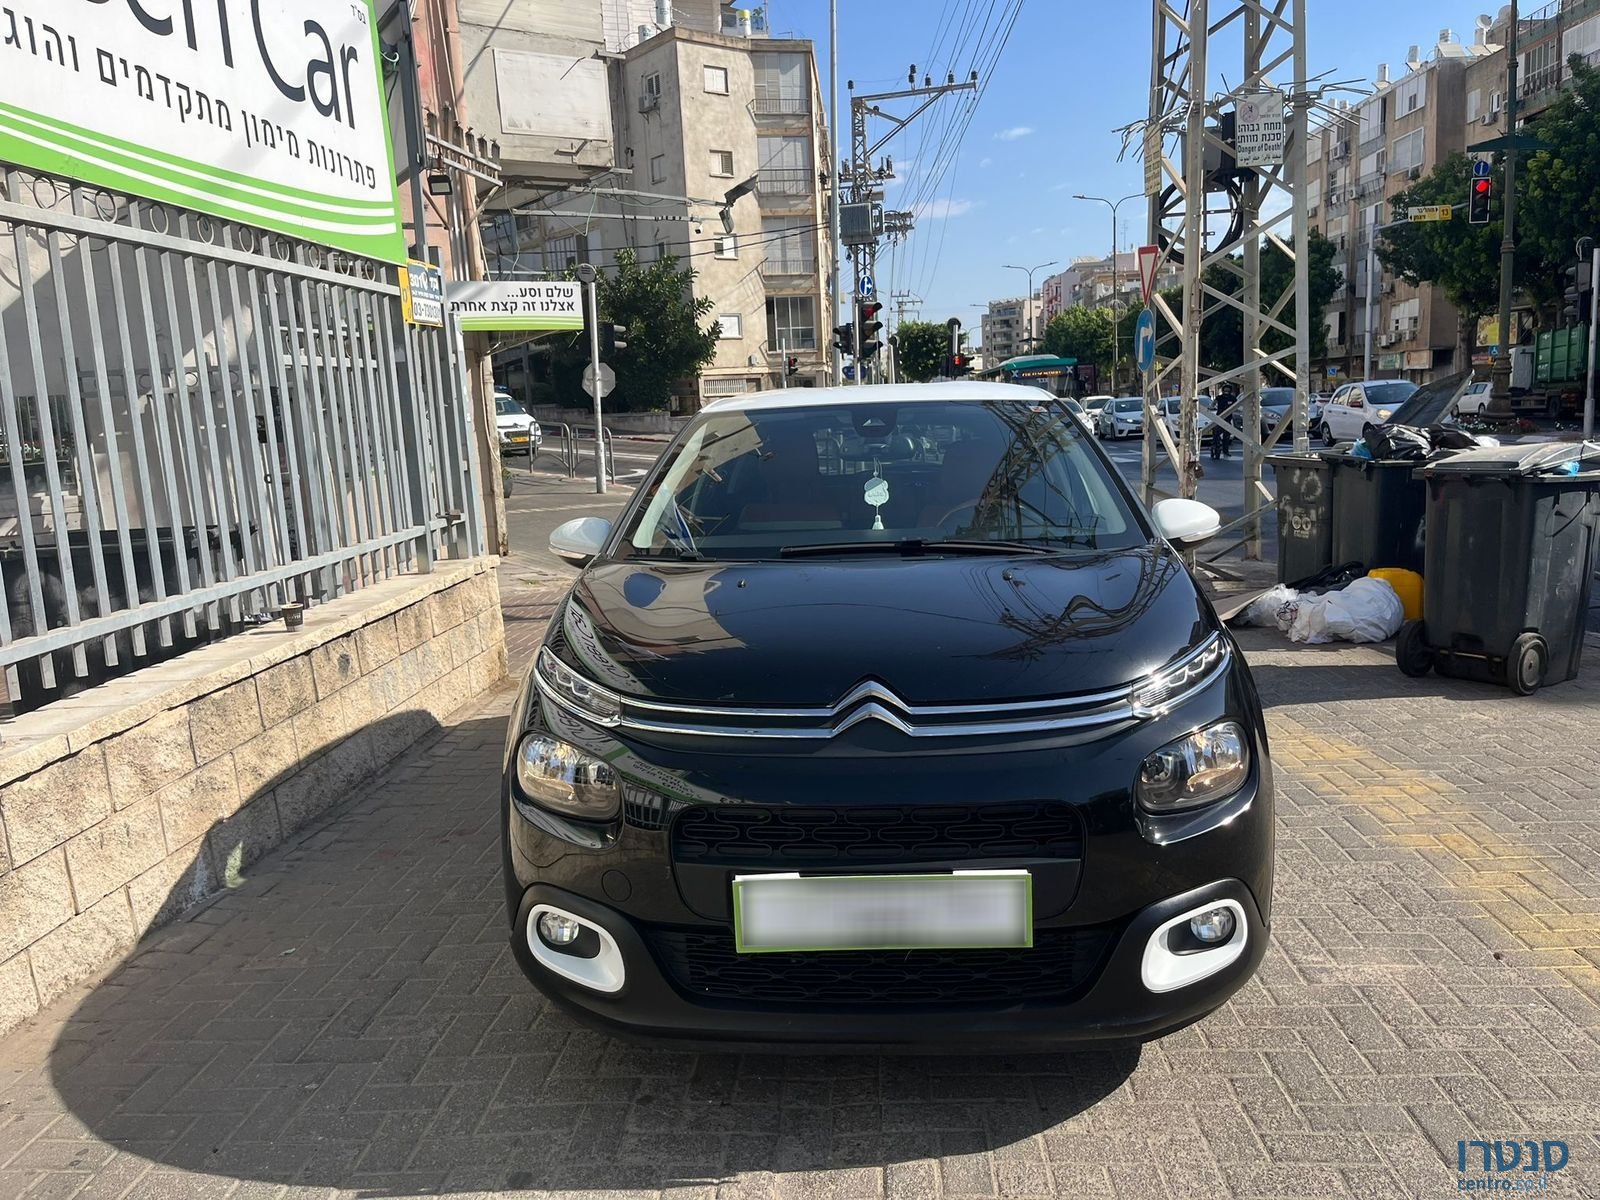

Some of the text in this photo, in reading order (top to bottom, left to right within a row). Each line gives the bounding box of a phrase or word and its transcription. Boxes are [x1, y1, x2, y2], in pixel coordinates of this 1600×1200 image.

[96, 47, 232, 131] מתקדמים
[1263, 122, 1282, 131] מתח
[241, 110, 300, 159] מימון
[1261, 132, 1282, 142] סכנת
[1237, 145, 1257, 155] Danger
[1257, 143, 1264, 152] of
[307, 138, 376, 190] פתרונות
[1441, 208, 1449, 217] 13
[506, 287, 542, 298] וסע...
[545, 285, 574, 298] שלם
[450, 299, 575, 314] אצלנו זה קצת אחרת
